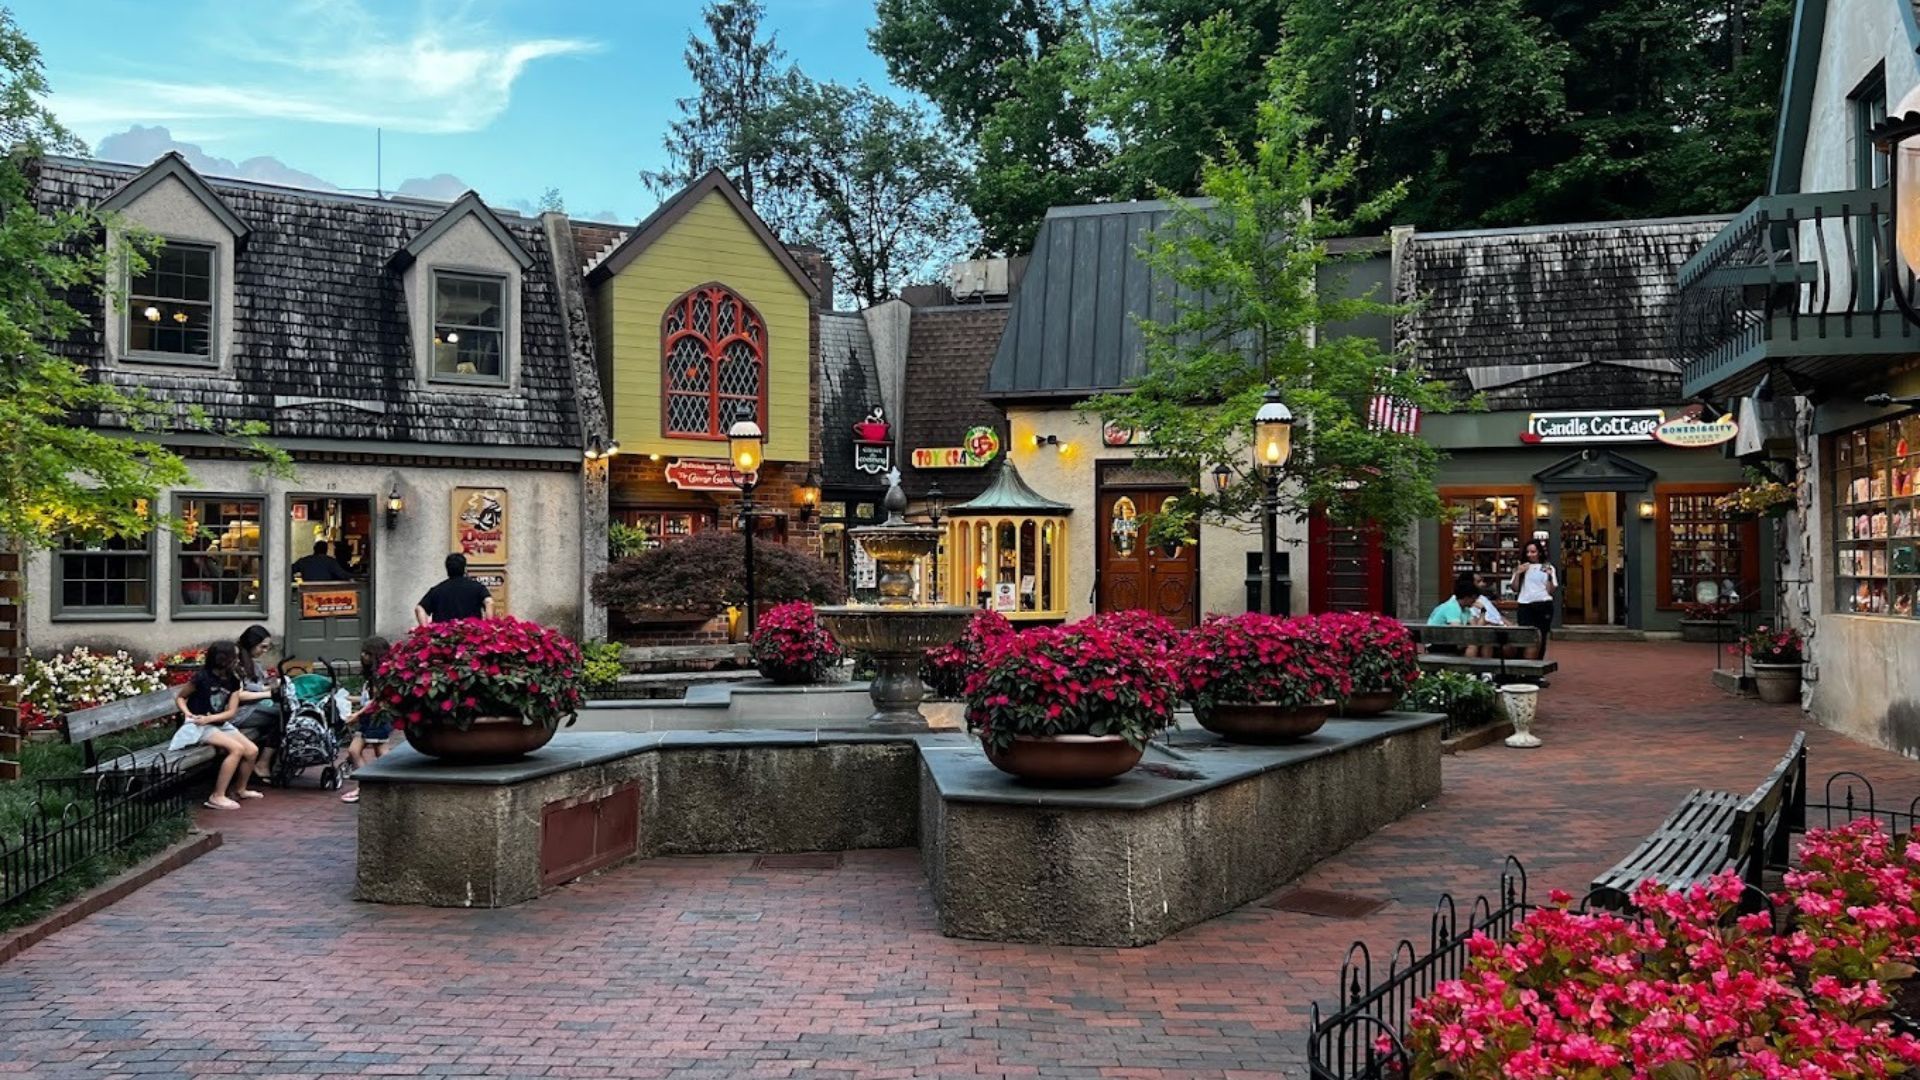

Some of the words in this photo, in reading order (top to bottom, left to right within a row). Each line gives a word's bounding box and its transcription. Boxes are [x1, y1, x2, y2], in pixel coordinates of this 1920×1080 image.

[1537, 418, 1587, 436] Candle
[1590, 416, 1657, 435] Cottage
[1661, 425, 1732, 434] BONEDIGGITY
[916, 450, 940, 466] TOY
[461, 528, 502, 542] Donut
[462, 543, 498, 555] Friar
